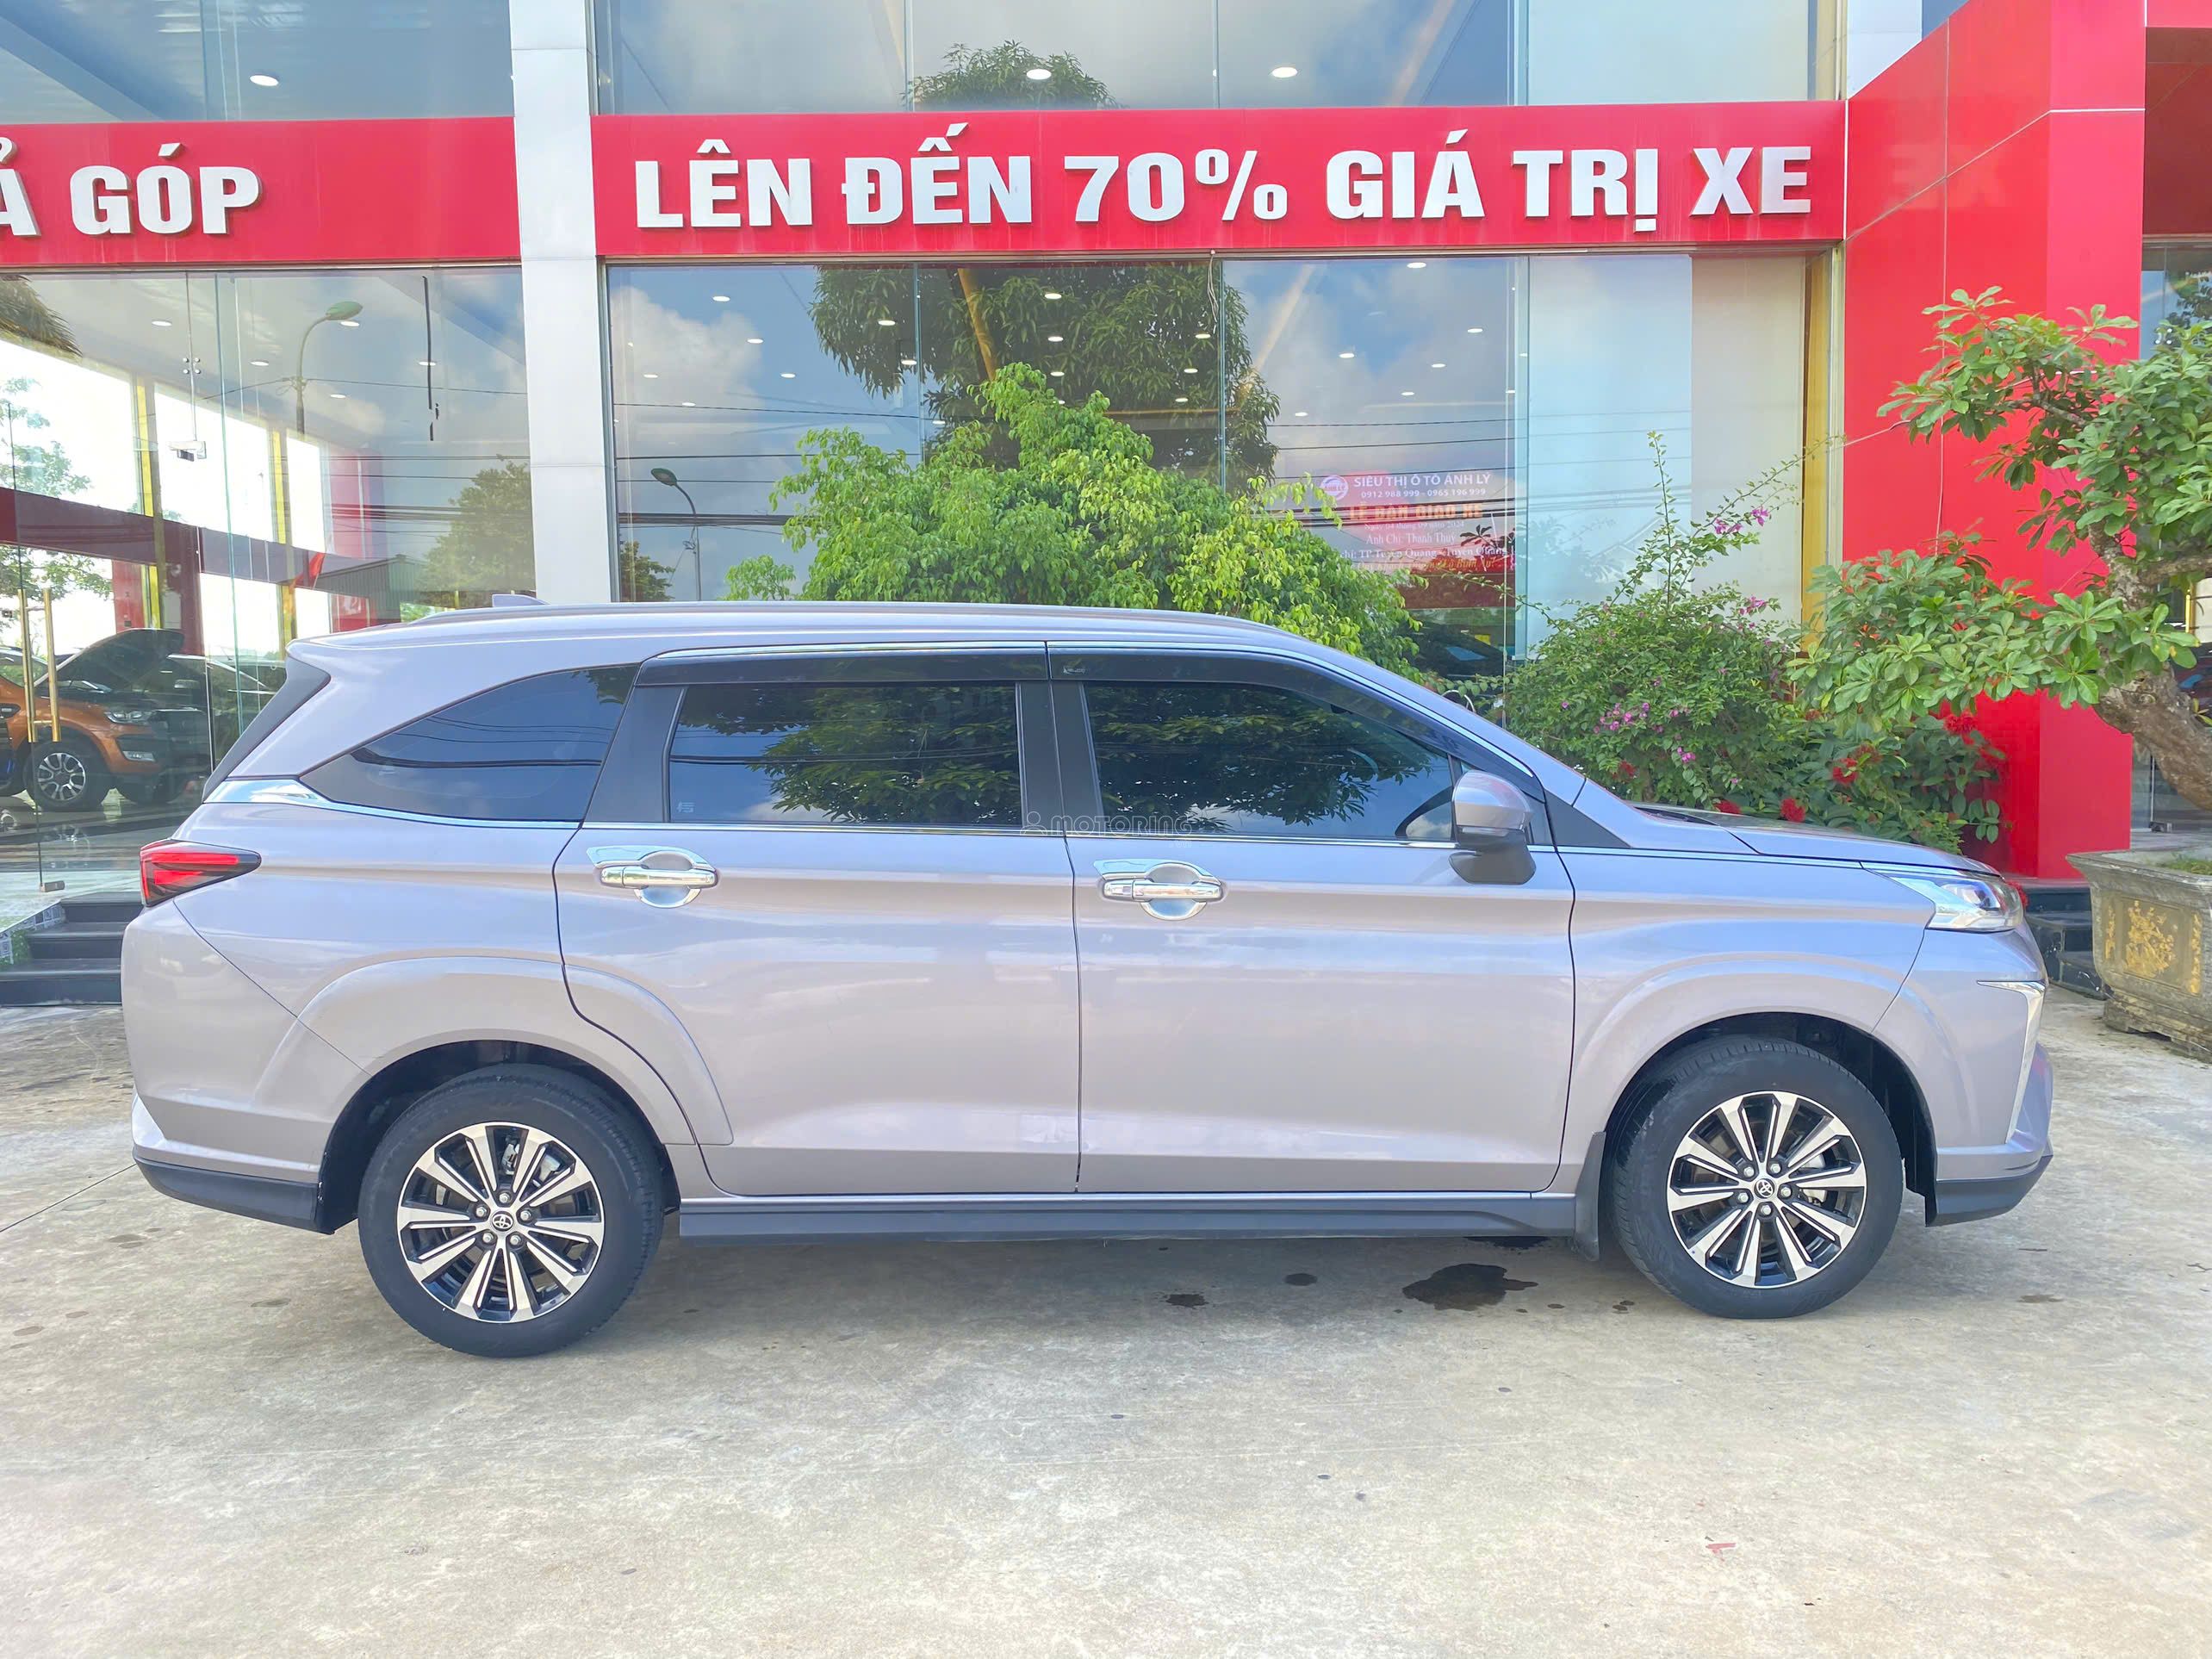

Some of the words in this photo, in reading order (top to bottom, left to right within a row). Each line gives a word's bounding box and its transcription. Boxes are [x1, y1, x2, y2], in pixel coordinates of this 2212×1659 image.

[70, 143, 262, 235] GÓP
[636, 139, 814, 228] LÊN
[842, 122, 1033, 226] ĐẾN
[1065, 149, 1289, 222] 70%
[1327, 129, 1485, 220] GIÁ
[1512, 148, 1658, 233] TRỊ
[1689, 146, 1811, 217] XE
[1353, 475, 1383, 488] SIÊU
[1386, 475, 1407, 488] THỊ
